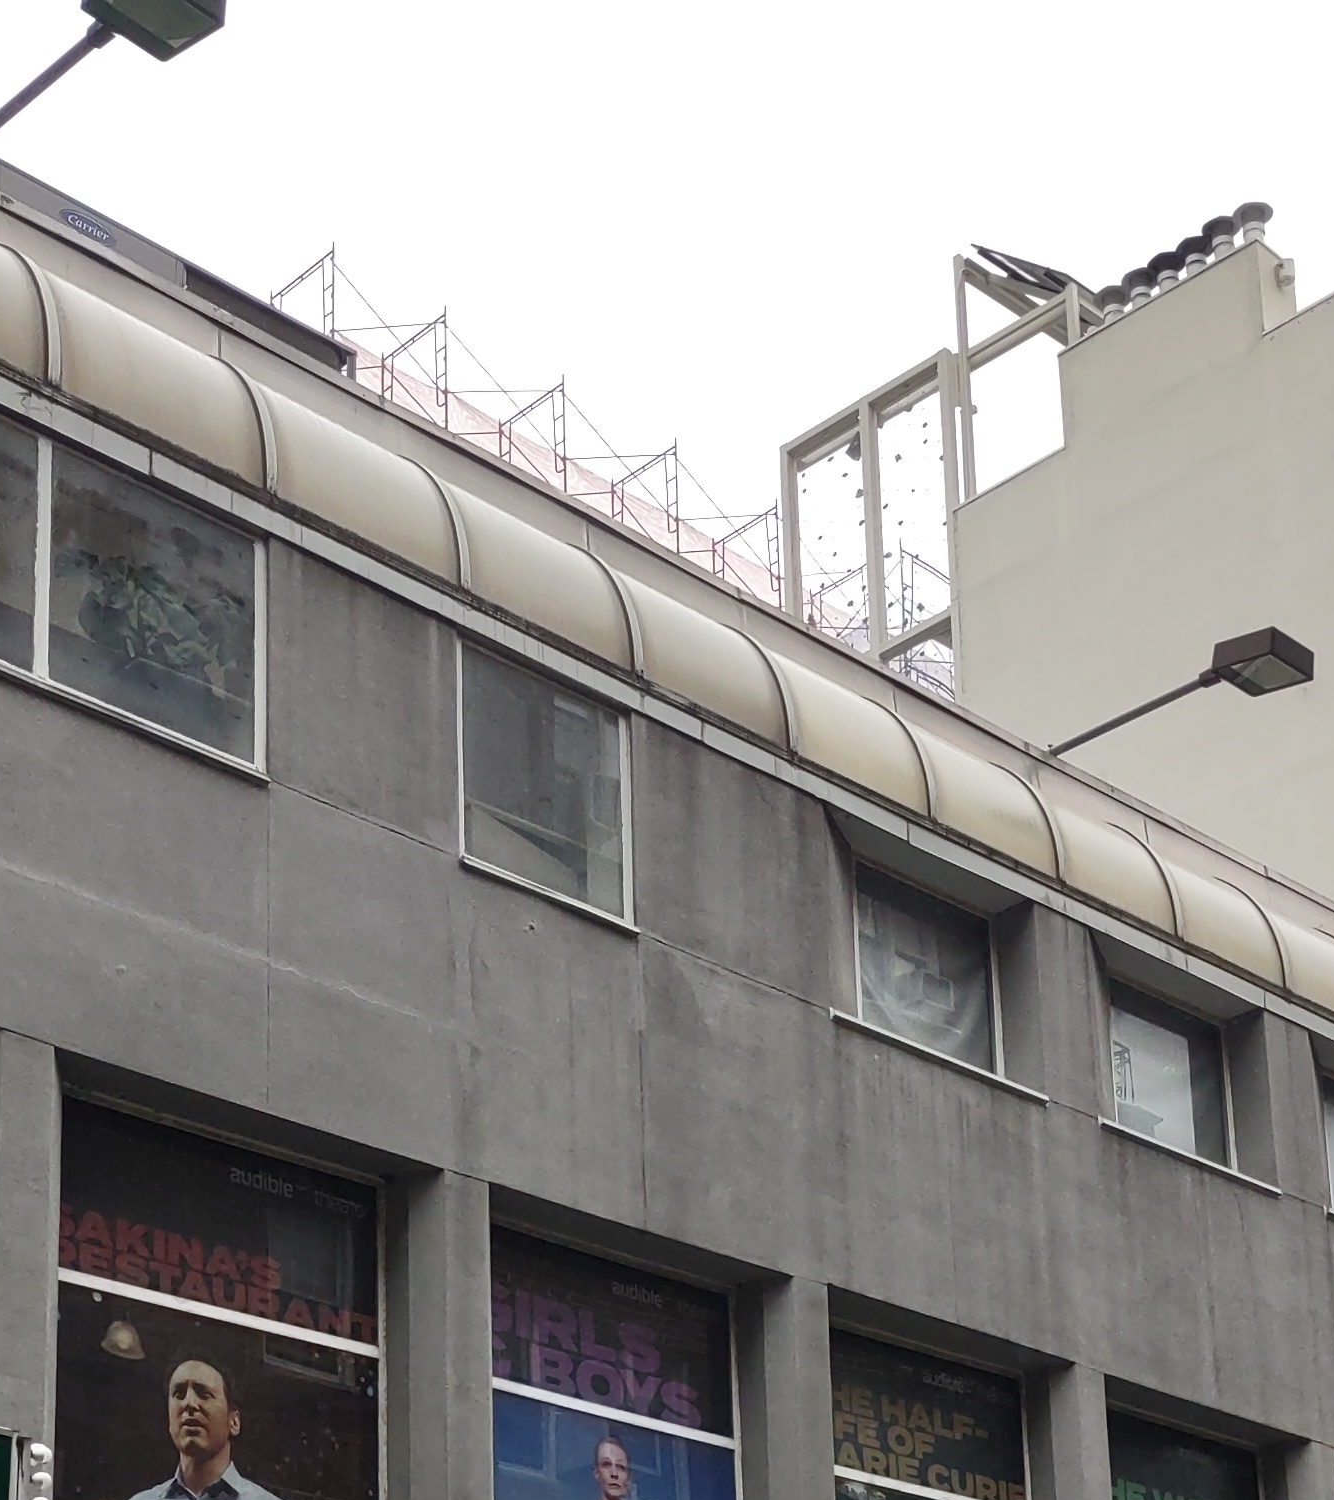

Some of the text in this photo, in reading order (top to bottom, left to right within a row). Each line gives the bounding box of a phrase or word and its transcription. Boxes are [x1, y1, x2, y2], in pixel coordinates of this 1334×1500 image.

[230, 1167, 294, 1199] audible
[612, 1281, 663, 1307] audible
[530, 1343, 703, 1429] BOYS
[833, 1383, 875, 1418] HE
[887, 1425, 936, 1459] OF
[835, 1442, 922, 1486] ARIE
